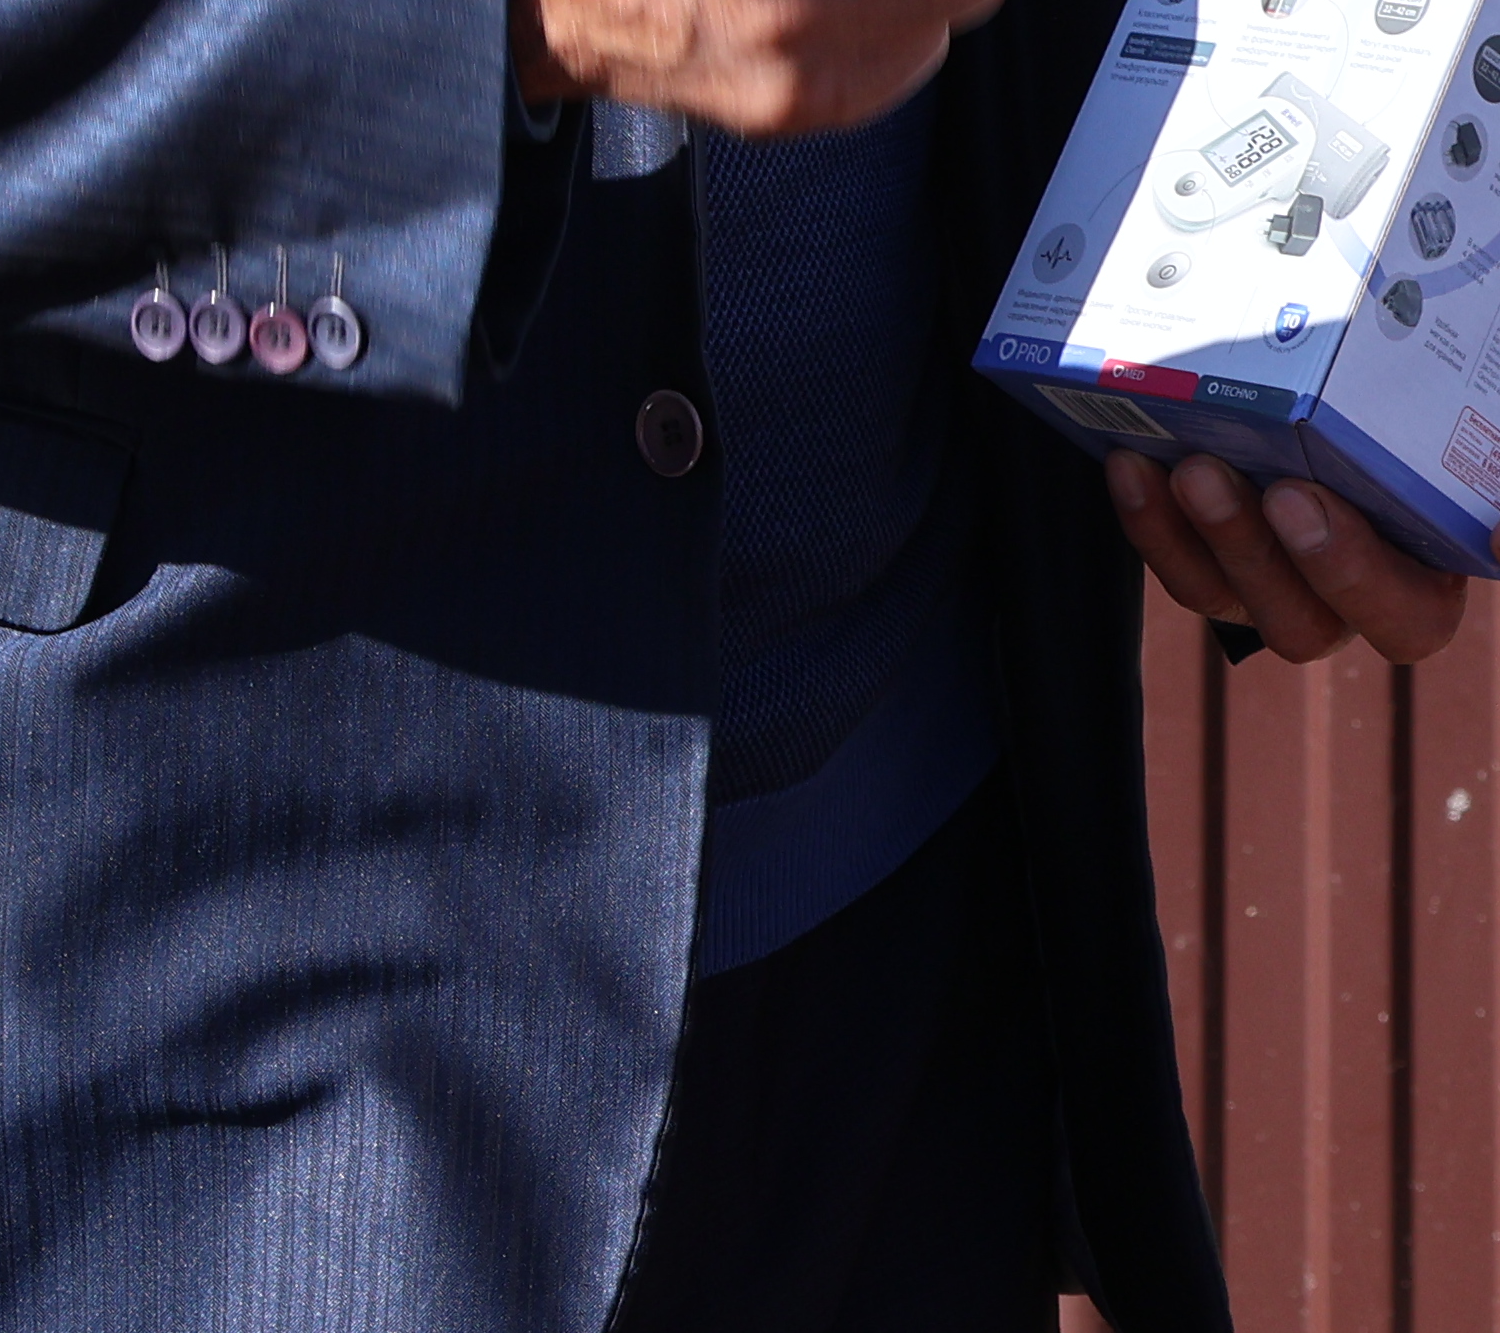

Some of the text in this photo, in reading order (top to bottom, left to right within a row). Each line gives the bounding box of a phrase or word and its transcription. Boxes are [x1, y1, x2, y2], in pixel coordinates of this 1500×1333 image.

[1283, 313, 1301, 329] 10
[1015, 342, 1052, 365] PRO
[1122, 367, 1146, 381] MED
[1220, 384, 1258, 401] TECHNO
